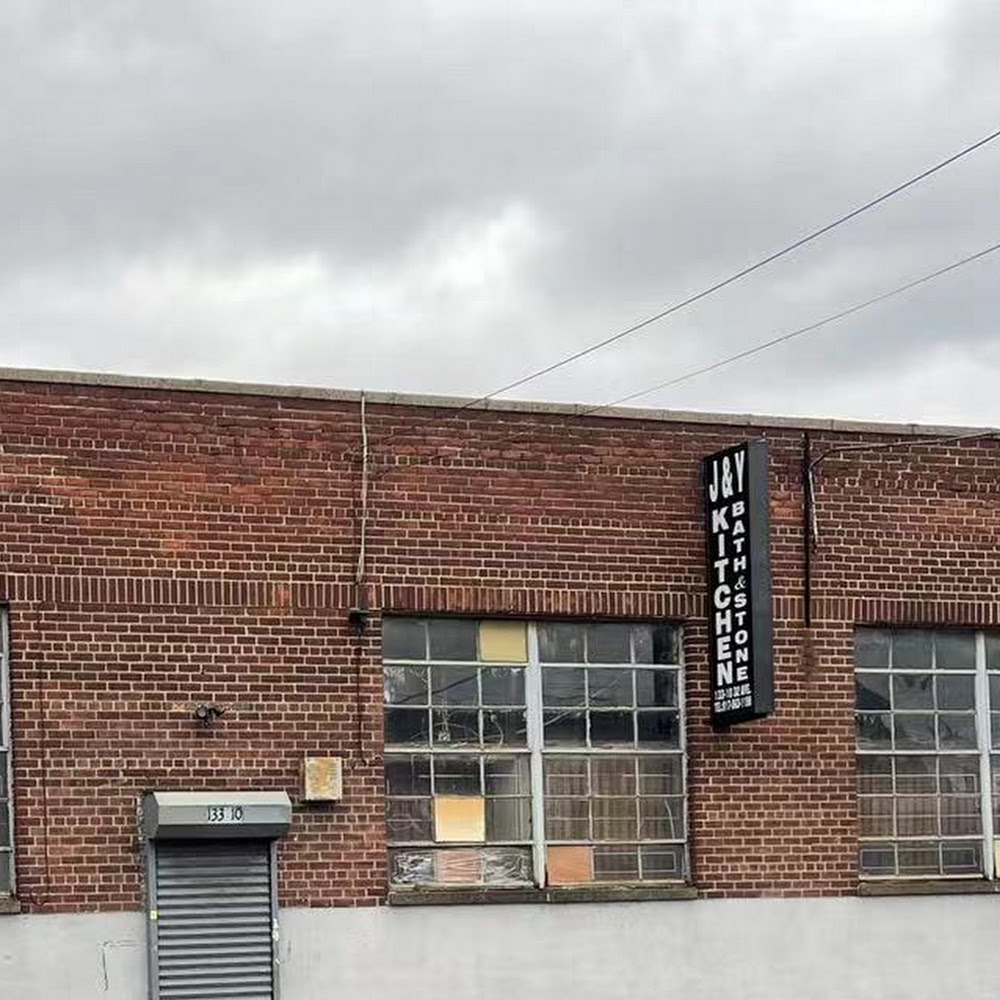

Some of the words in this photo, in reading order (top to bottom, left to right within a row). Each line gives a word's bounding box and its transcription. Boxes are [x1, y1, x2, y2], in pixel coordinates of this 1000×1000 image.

[709, 450, 745, 502] J&Y
[712, 506, 733, 686] KITCHEN
[207, 806, 225, 822] 133
